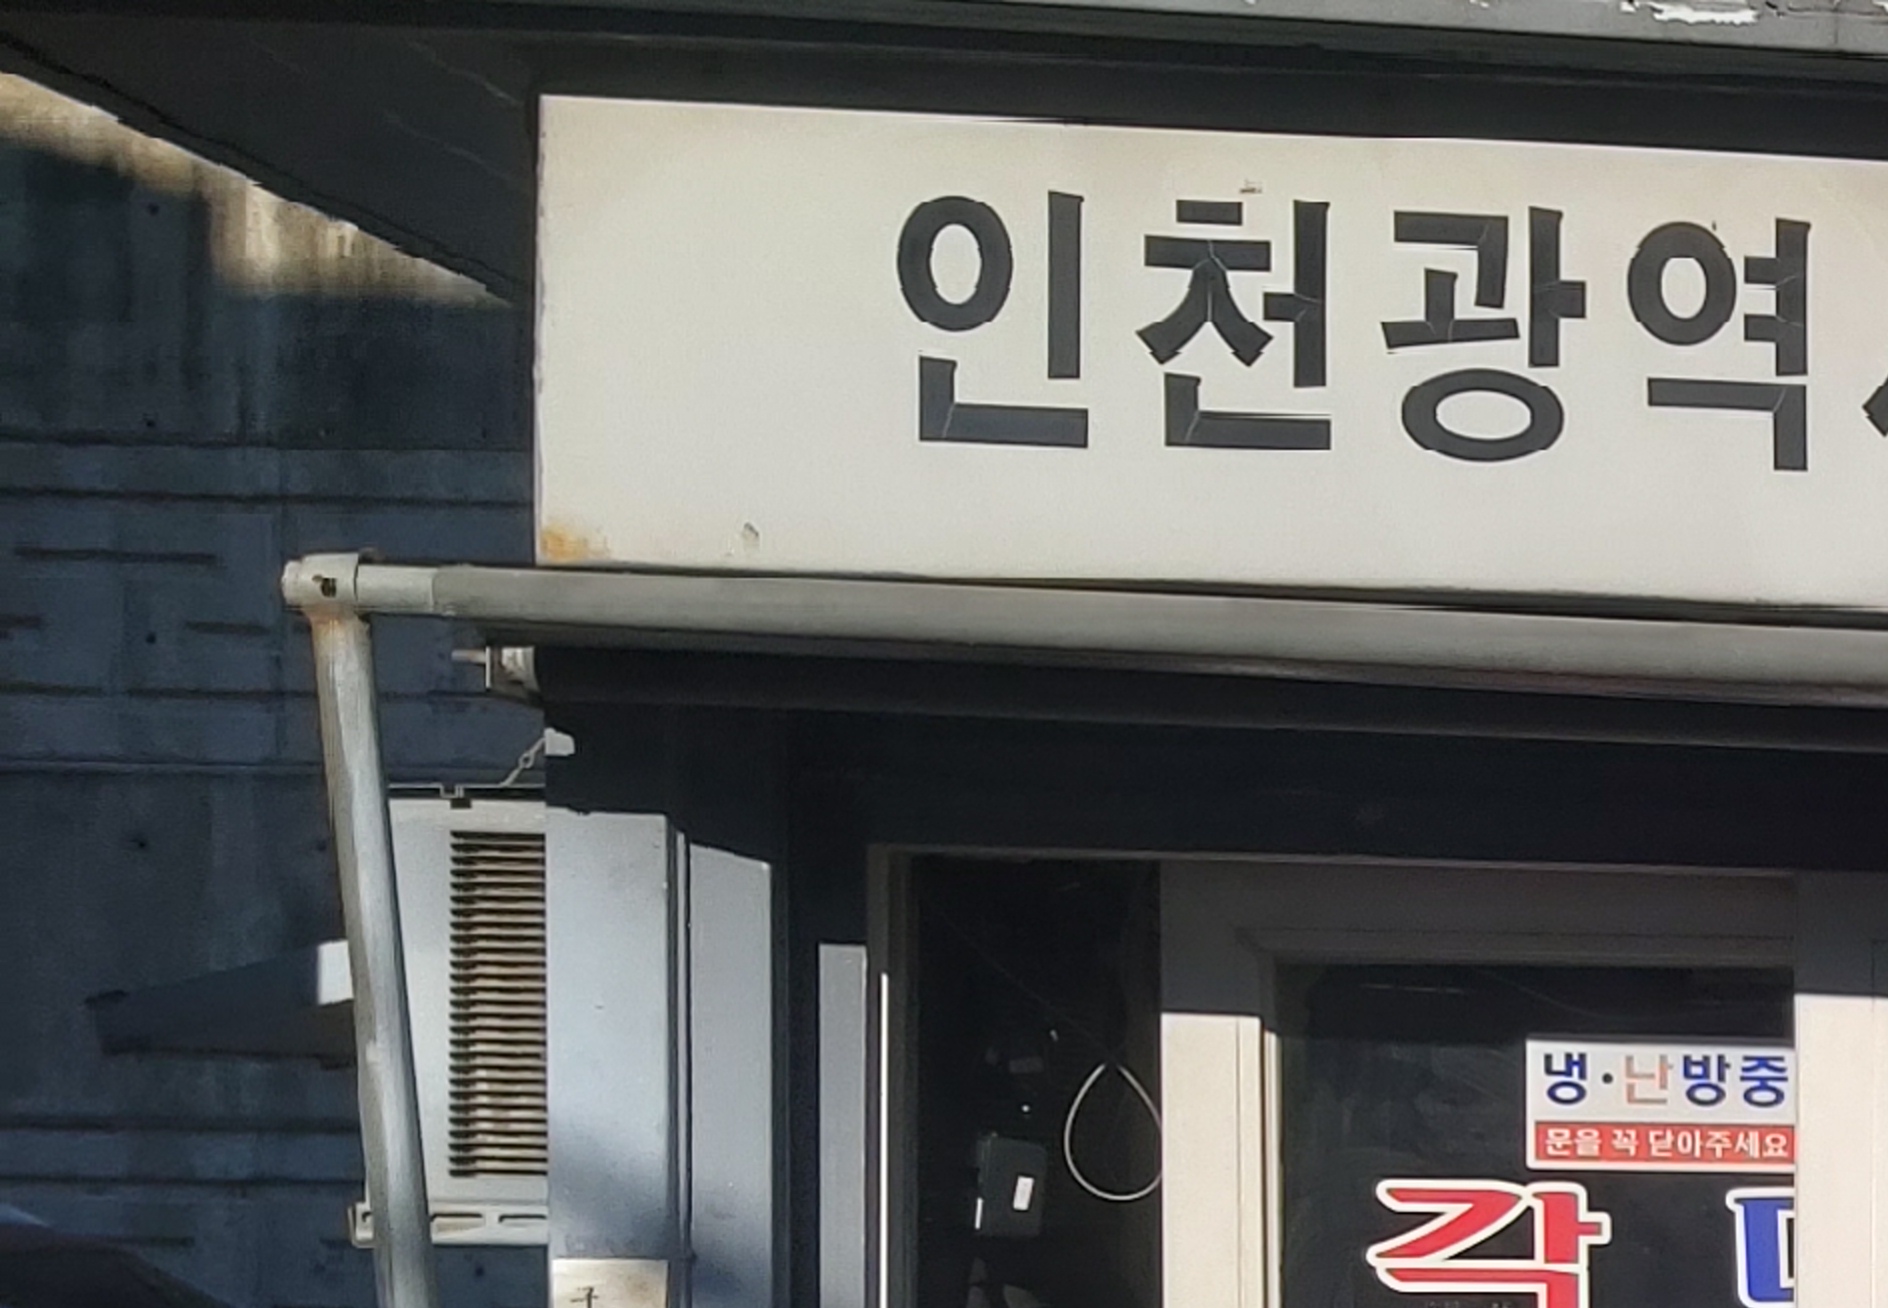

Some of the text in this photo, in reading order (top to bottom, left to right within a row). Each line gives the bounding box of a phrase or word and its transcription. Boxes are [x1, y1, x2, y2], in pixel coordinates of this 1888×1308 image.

[1545, 1126, 1789, 1160] 문을 꼭 닫아주세요
